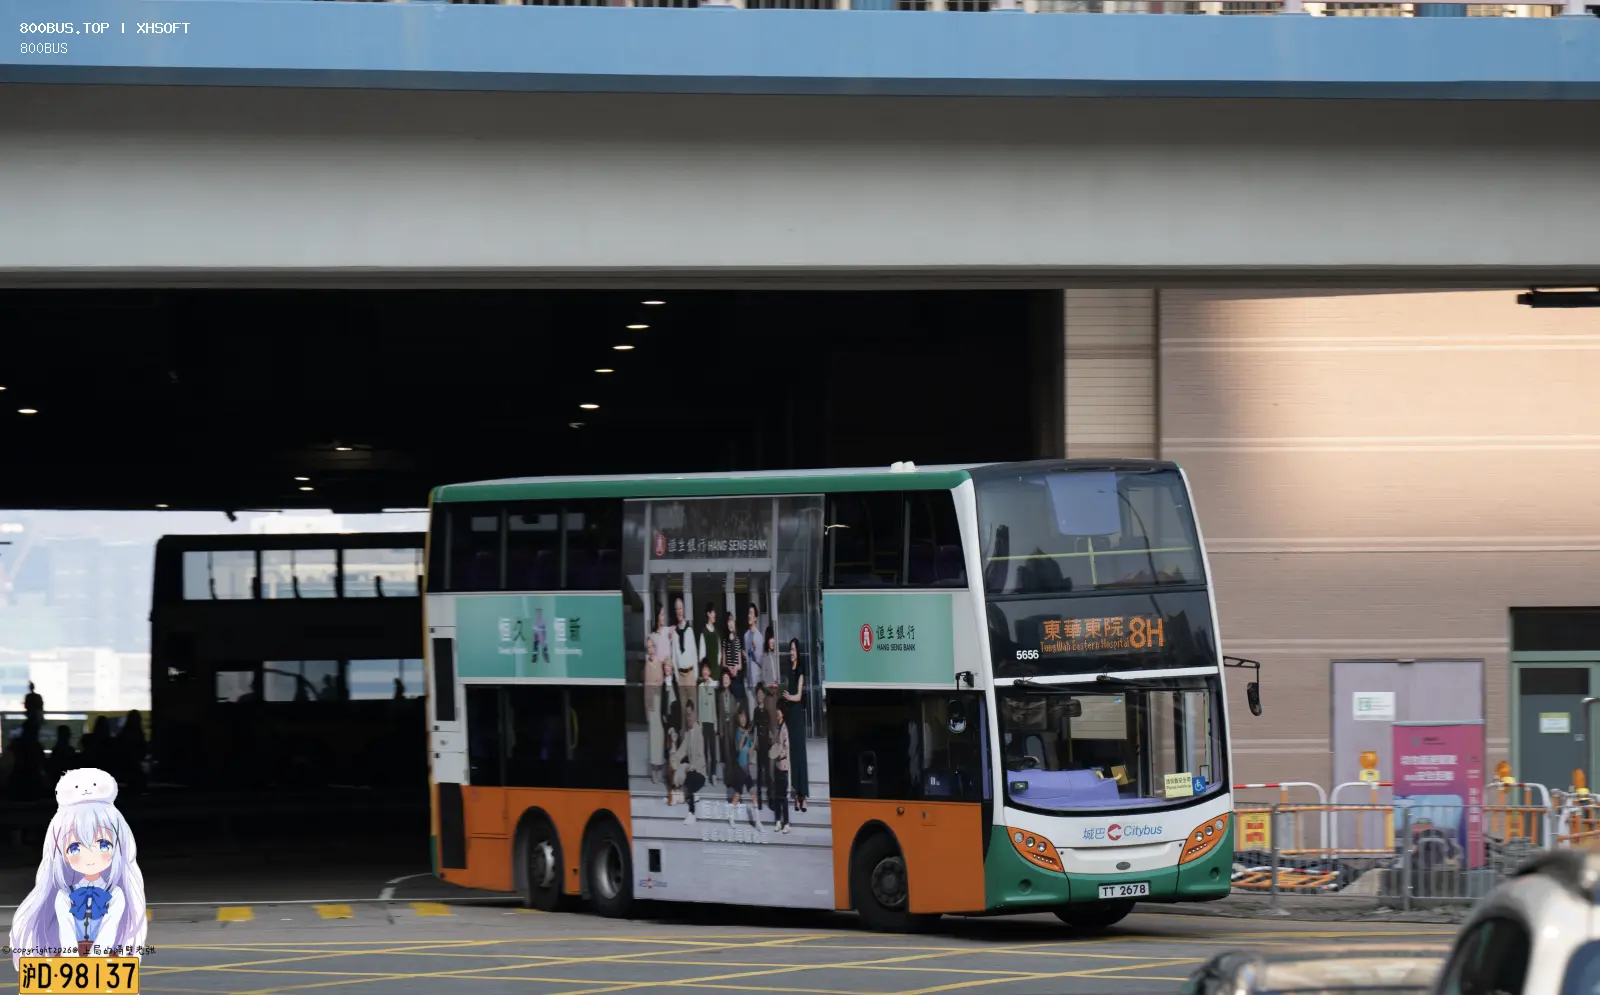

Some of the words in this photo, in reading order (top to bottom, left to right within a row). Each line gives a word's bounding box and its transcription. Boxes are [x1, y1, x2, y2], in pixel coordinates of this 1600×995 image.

[707, 539, 728, 552] HANG
[728, 539, 748, 552] SENG
[748, 539, 768, 551] BANK
[876, 624, 916, 640] 恒生銀行
[1043, 617, 1124, 641] 東華東院
[1129, 616, 1164, 648] 8H
[876, 643, 890, 651] HANG
[890, 643, 903, 652] SENG
[903, 643, 916, 651] BANK
[1101, 637, 1130, 649] Hospital
[1016, 650, 1039, 660] 5656
[1082, 827, 1106, 840] 城巴
[1123, 825, 1163, 837] Citybus
[1102, 887, 1116, 897] TT
[1119, 884, 1146, 896] 2678
